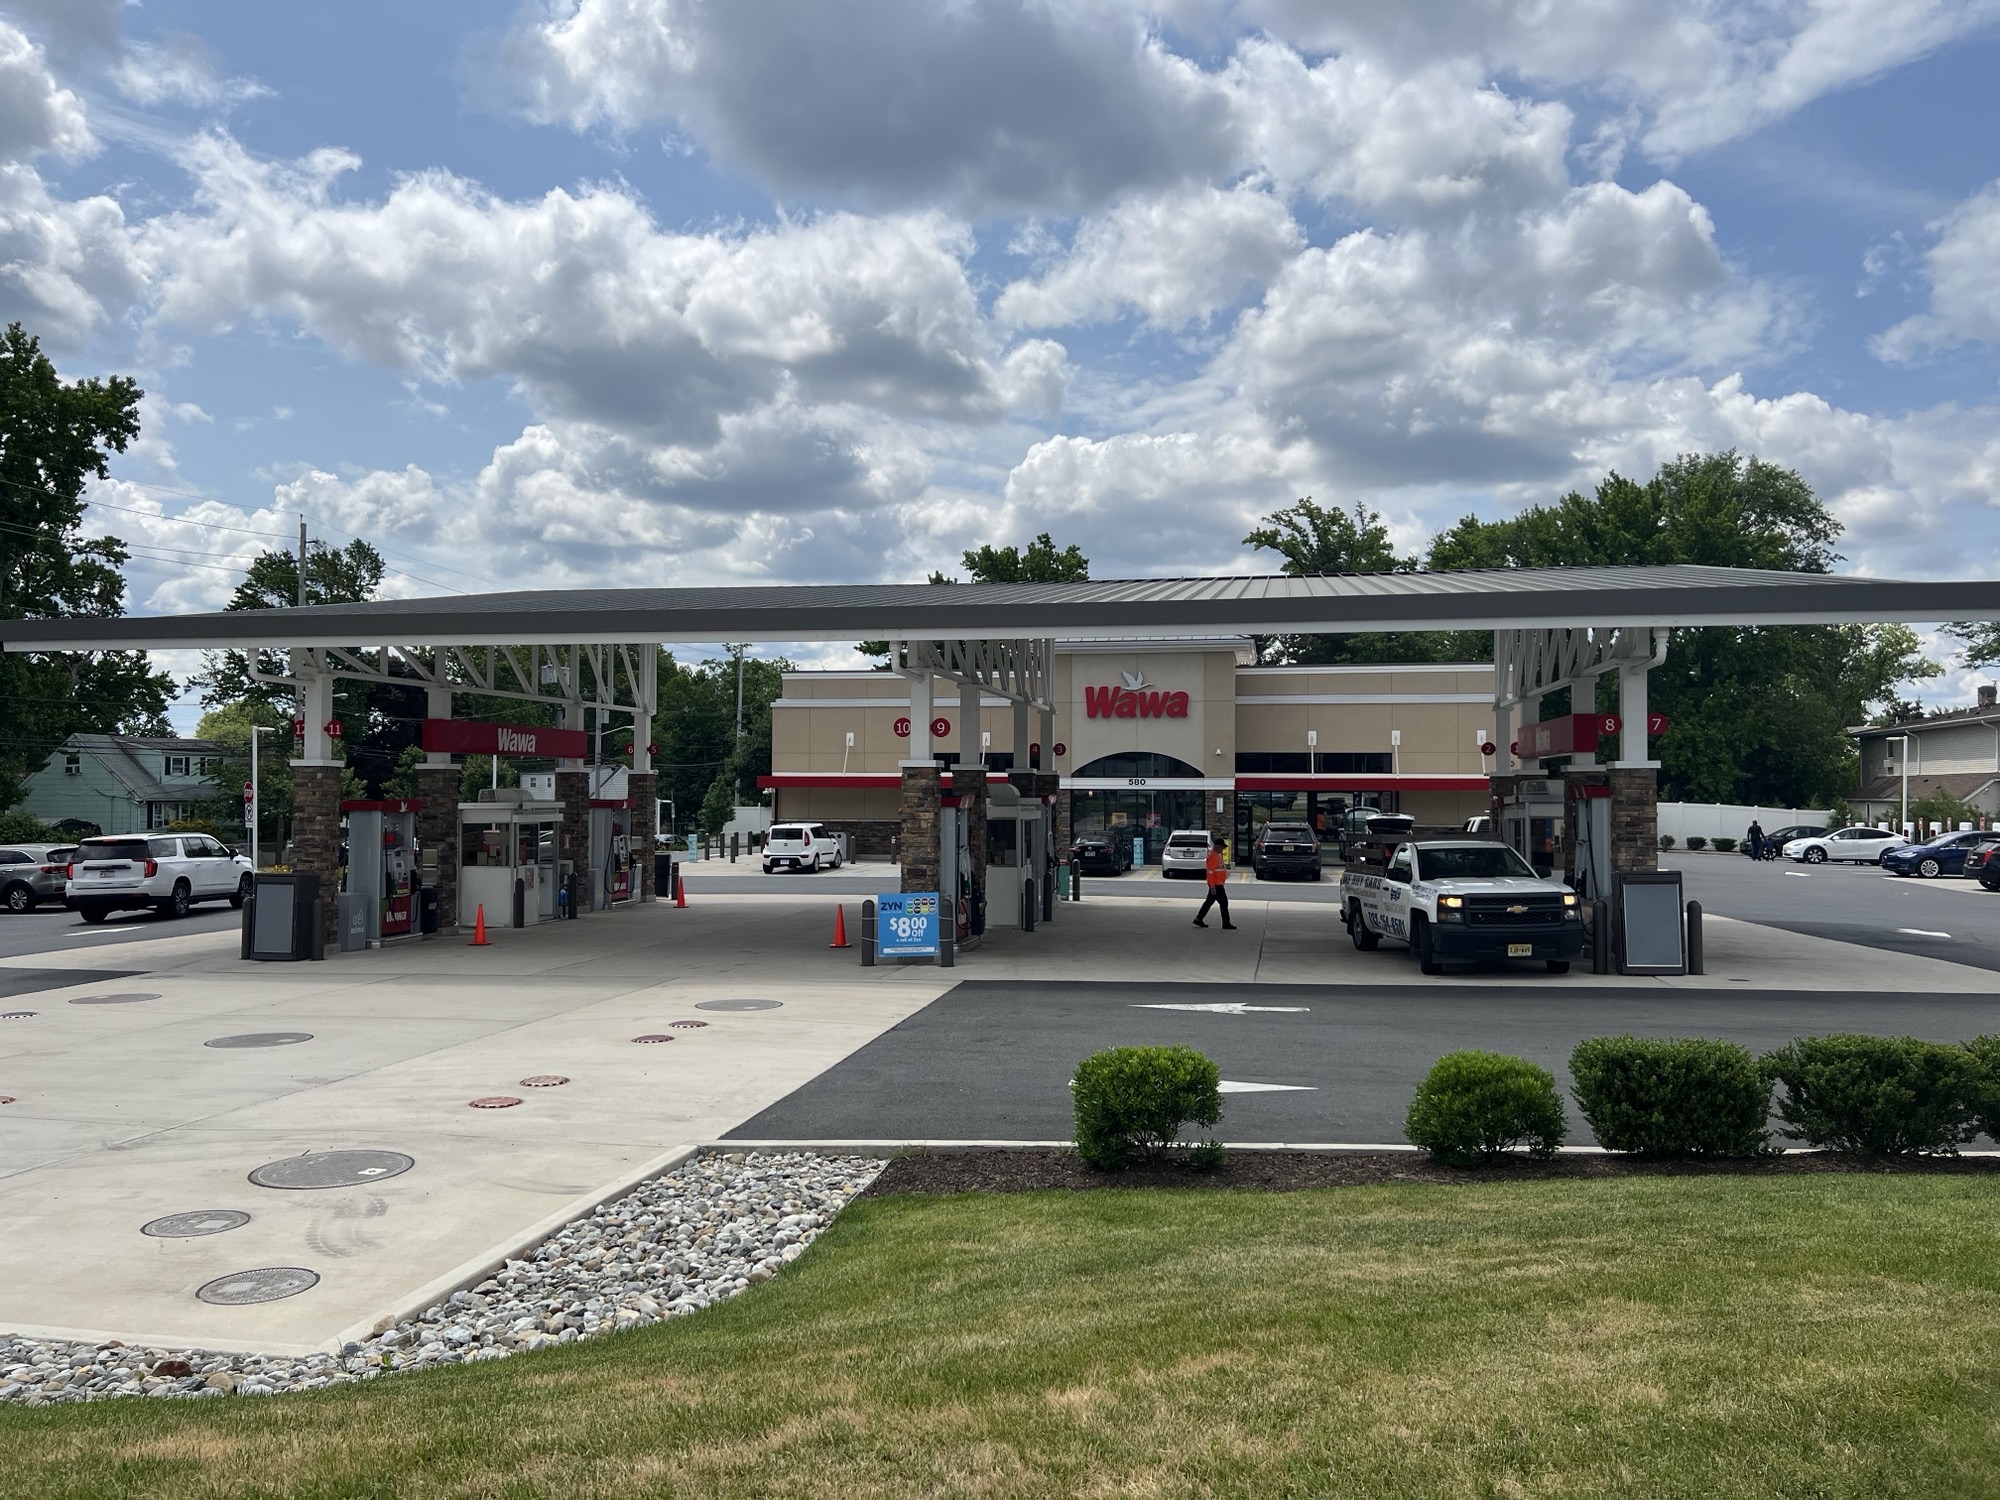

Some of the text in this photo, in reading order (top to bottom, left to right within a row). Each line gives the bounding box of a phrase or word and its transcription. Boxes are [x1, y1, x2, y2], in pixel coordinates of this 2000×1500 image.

[1085, 686, 1189, 719] Wawa
[328, 724, 341, 734] 11
[896, 722, 911, 733] 10
[936, 722, 945, 733] 9
[1605, 719, 1615, 731] 8
[1652, 718, 1662, 731] 7
[497, 727, 536, 753] Wawa
[1128, 778, 1146, 787] 580
[1364, 876, 1383, 890] CARS
[881, 901, 902, 911] ZYN
